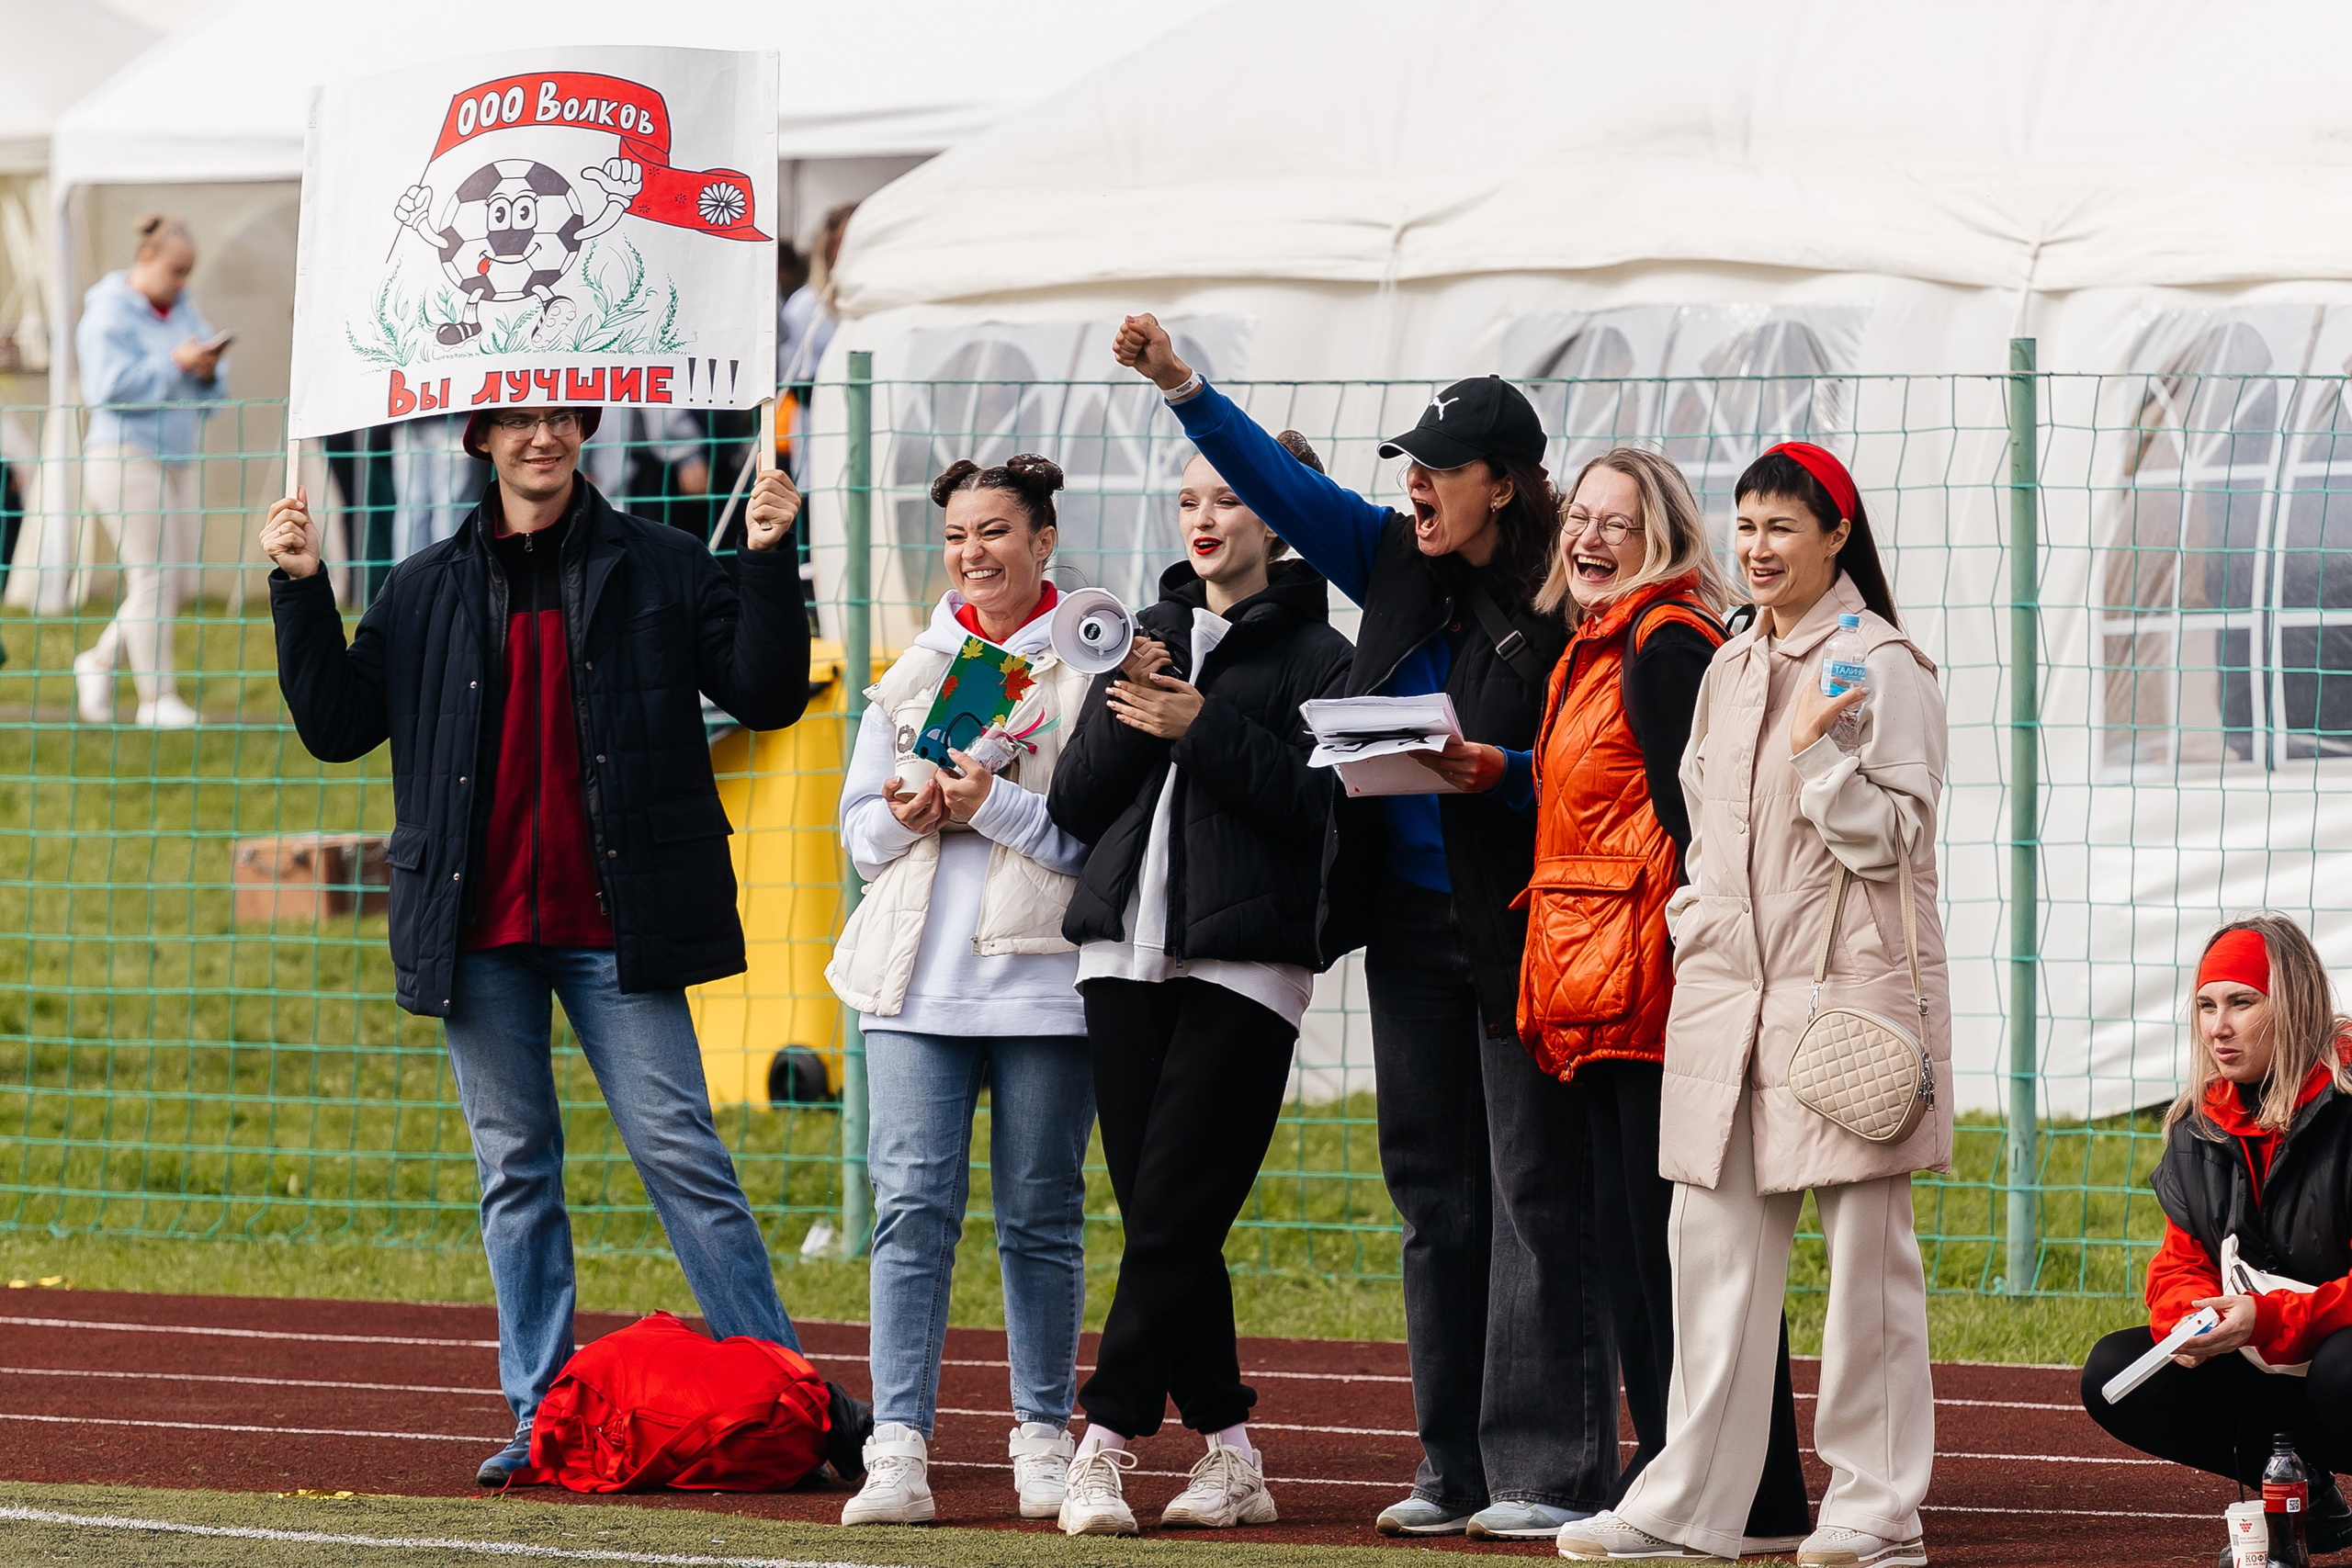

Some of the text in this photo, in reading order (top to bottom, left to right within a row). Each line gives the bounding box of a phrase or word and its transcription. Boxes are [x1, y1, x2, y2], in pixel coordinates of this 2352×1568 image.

[457, 81, 655, 137] ООО Волков
[388, 369, 450, 418] Вы
